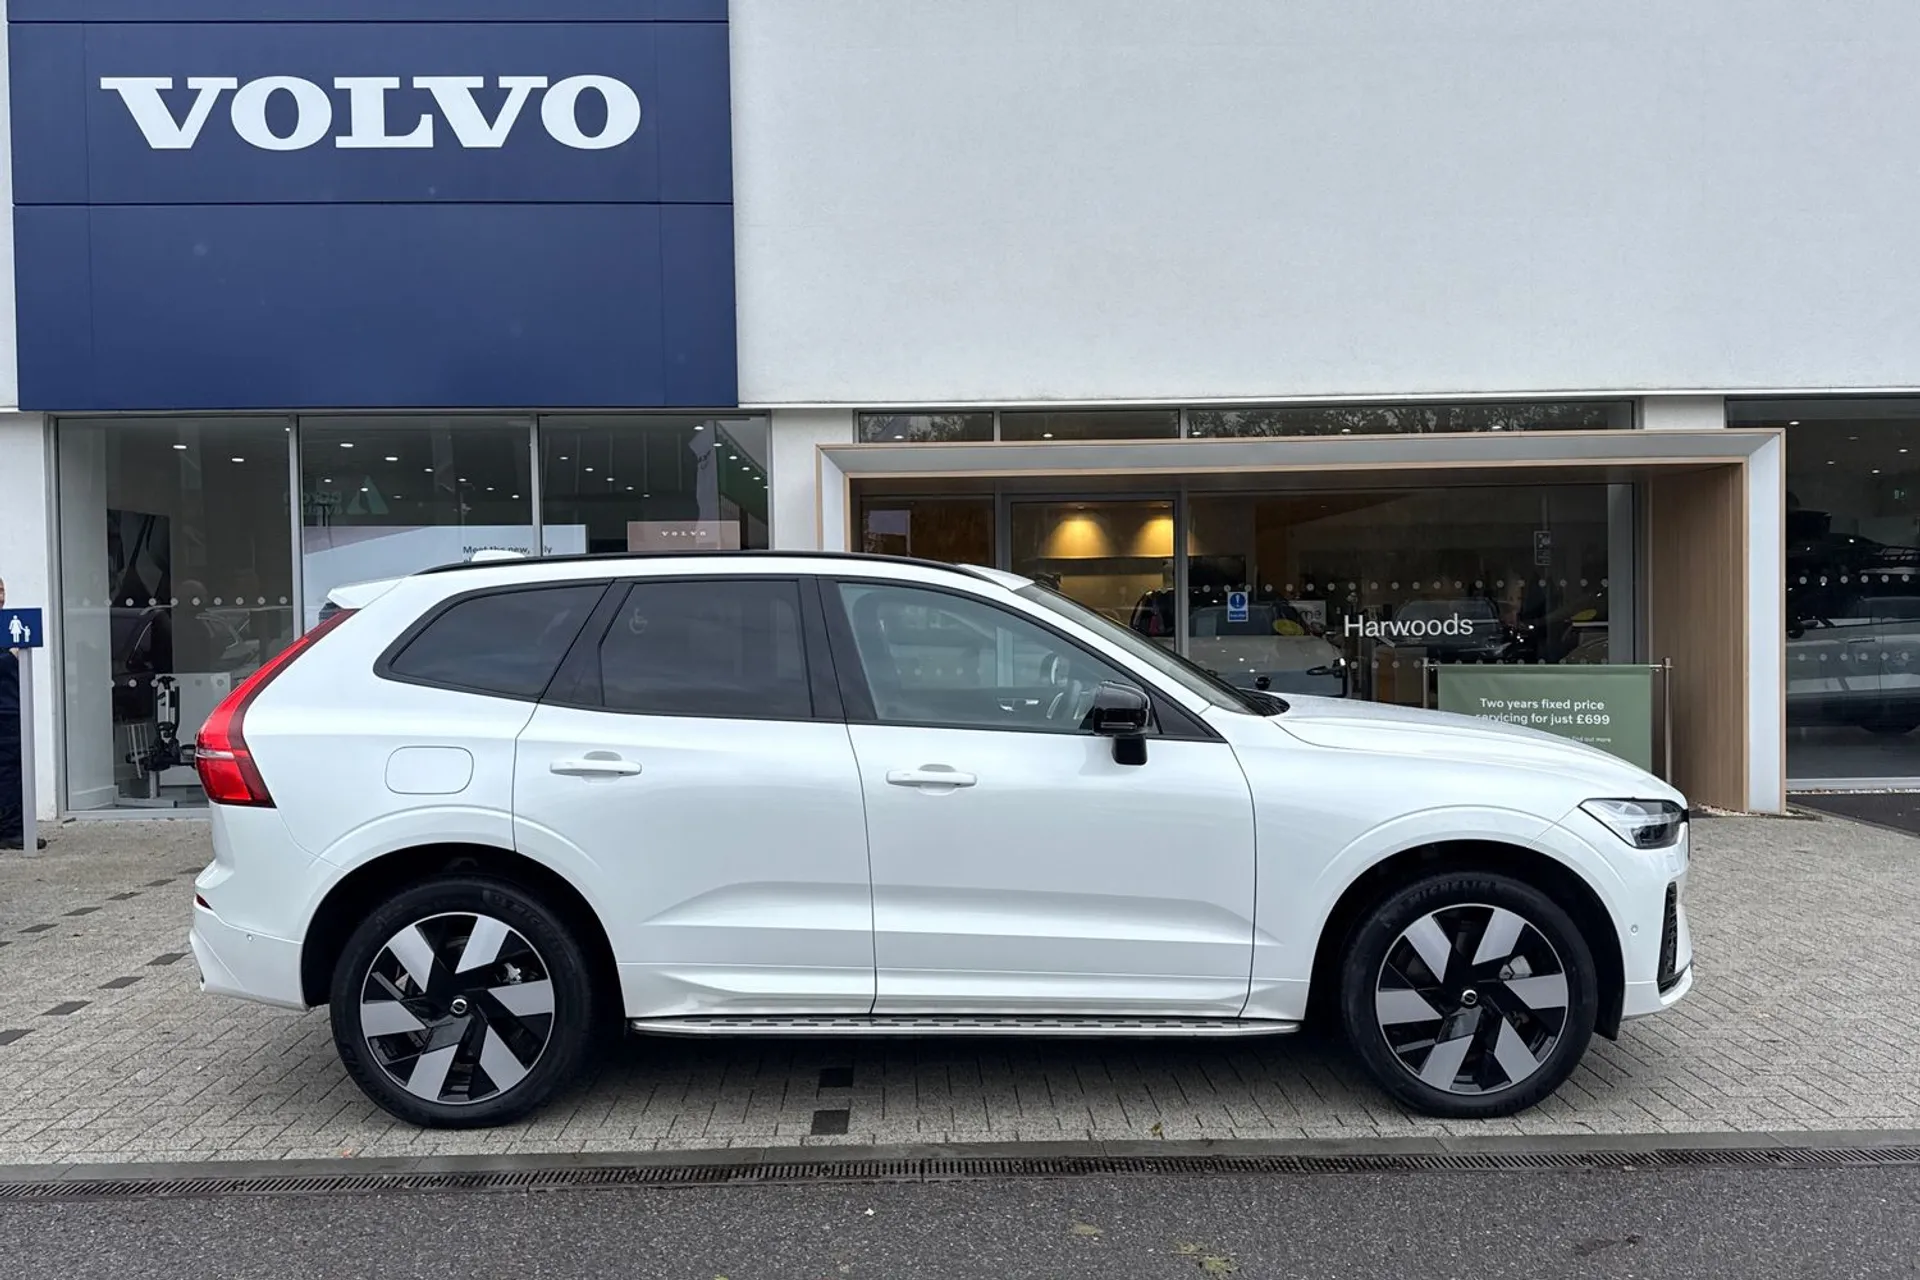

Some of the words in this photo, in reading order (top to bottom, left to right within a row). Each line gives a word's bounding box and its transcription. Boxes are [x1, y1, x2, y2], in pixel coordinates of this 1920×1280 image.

[100, 75, 641, 150] VOLVO
[1344, 612, 1474, 637] Harwoods
[1480, 698, 1504, 708] Two
[1507, 700, 1539, 710] years
[1541, 699, 1571, 709] fixed
[1574, 700, 1605, 712] price
[1531, 713, 1548, 724] for
[1550, 713, 1573, 725] just
[1576, 714, 1611, 725] £699
